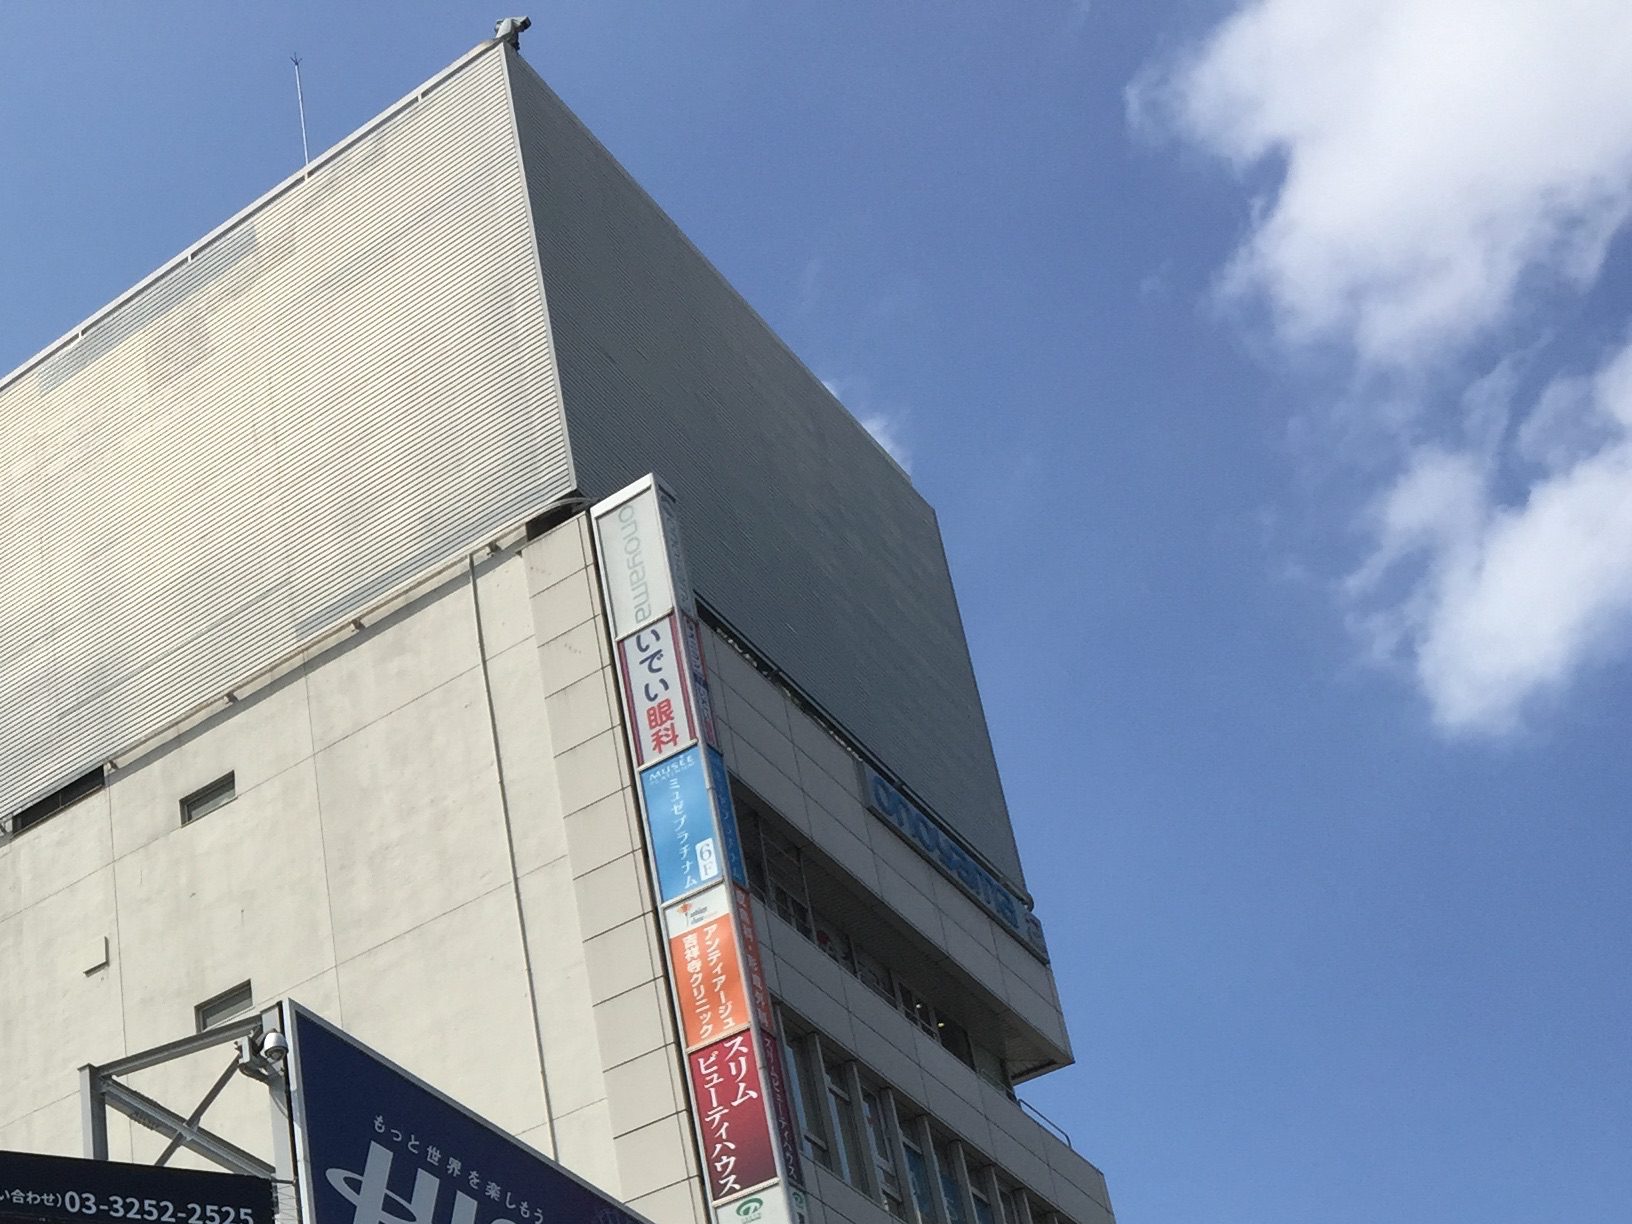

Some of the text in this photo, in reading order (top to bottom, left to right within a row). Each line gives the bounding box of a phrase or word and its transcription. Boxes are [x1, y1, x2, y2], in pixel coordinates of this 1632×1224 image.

[636, 628, 679, 754] いでい眼科
[703, 923, 736, 1029] アンティアージュ
[698, 1050, 740, 1196] ビューティハウス
[723, 1036, 758, 1107] スリム
